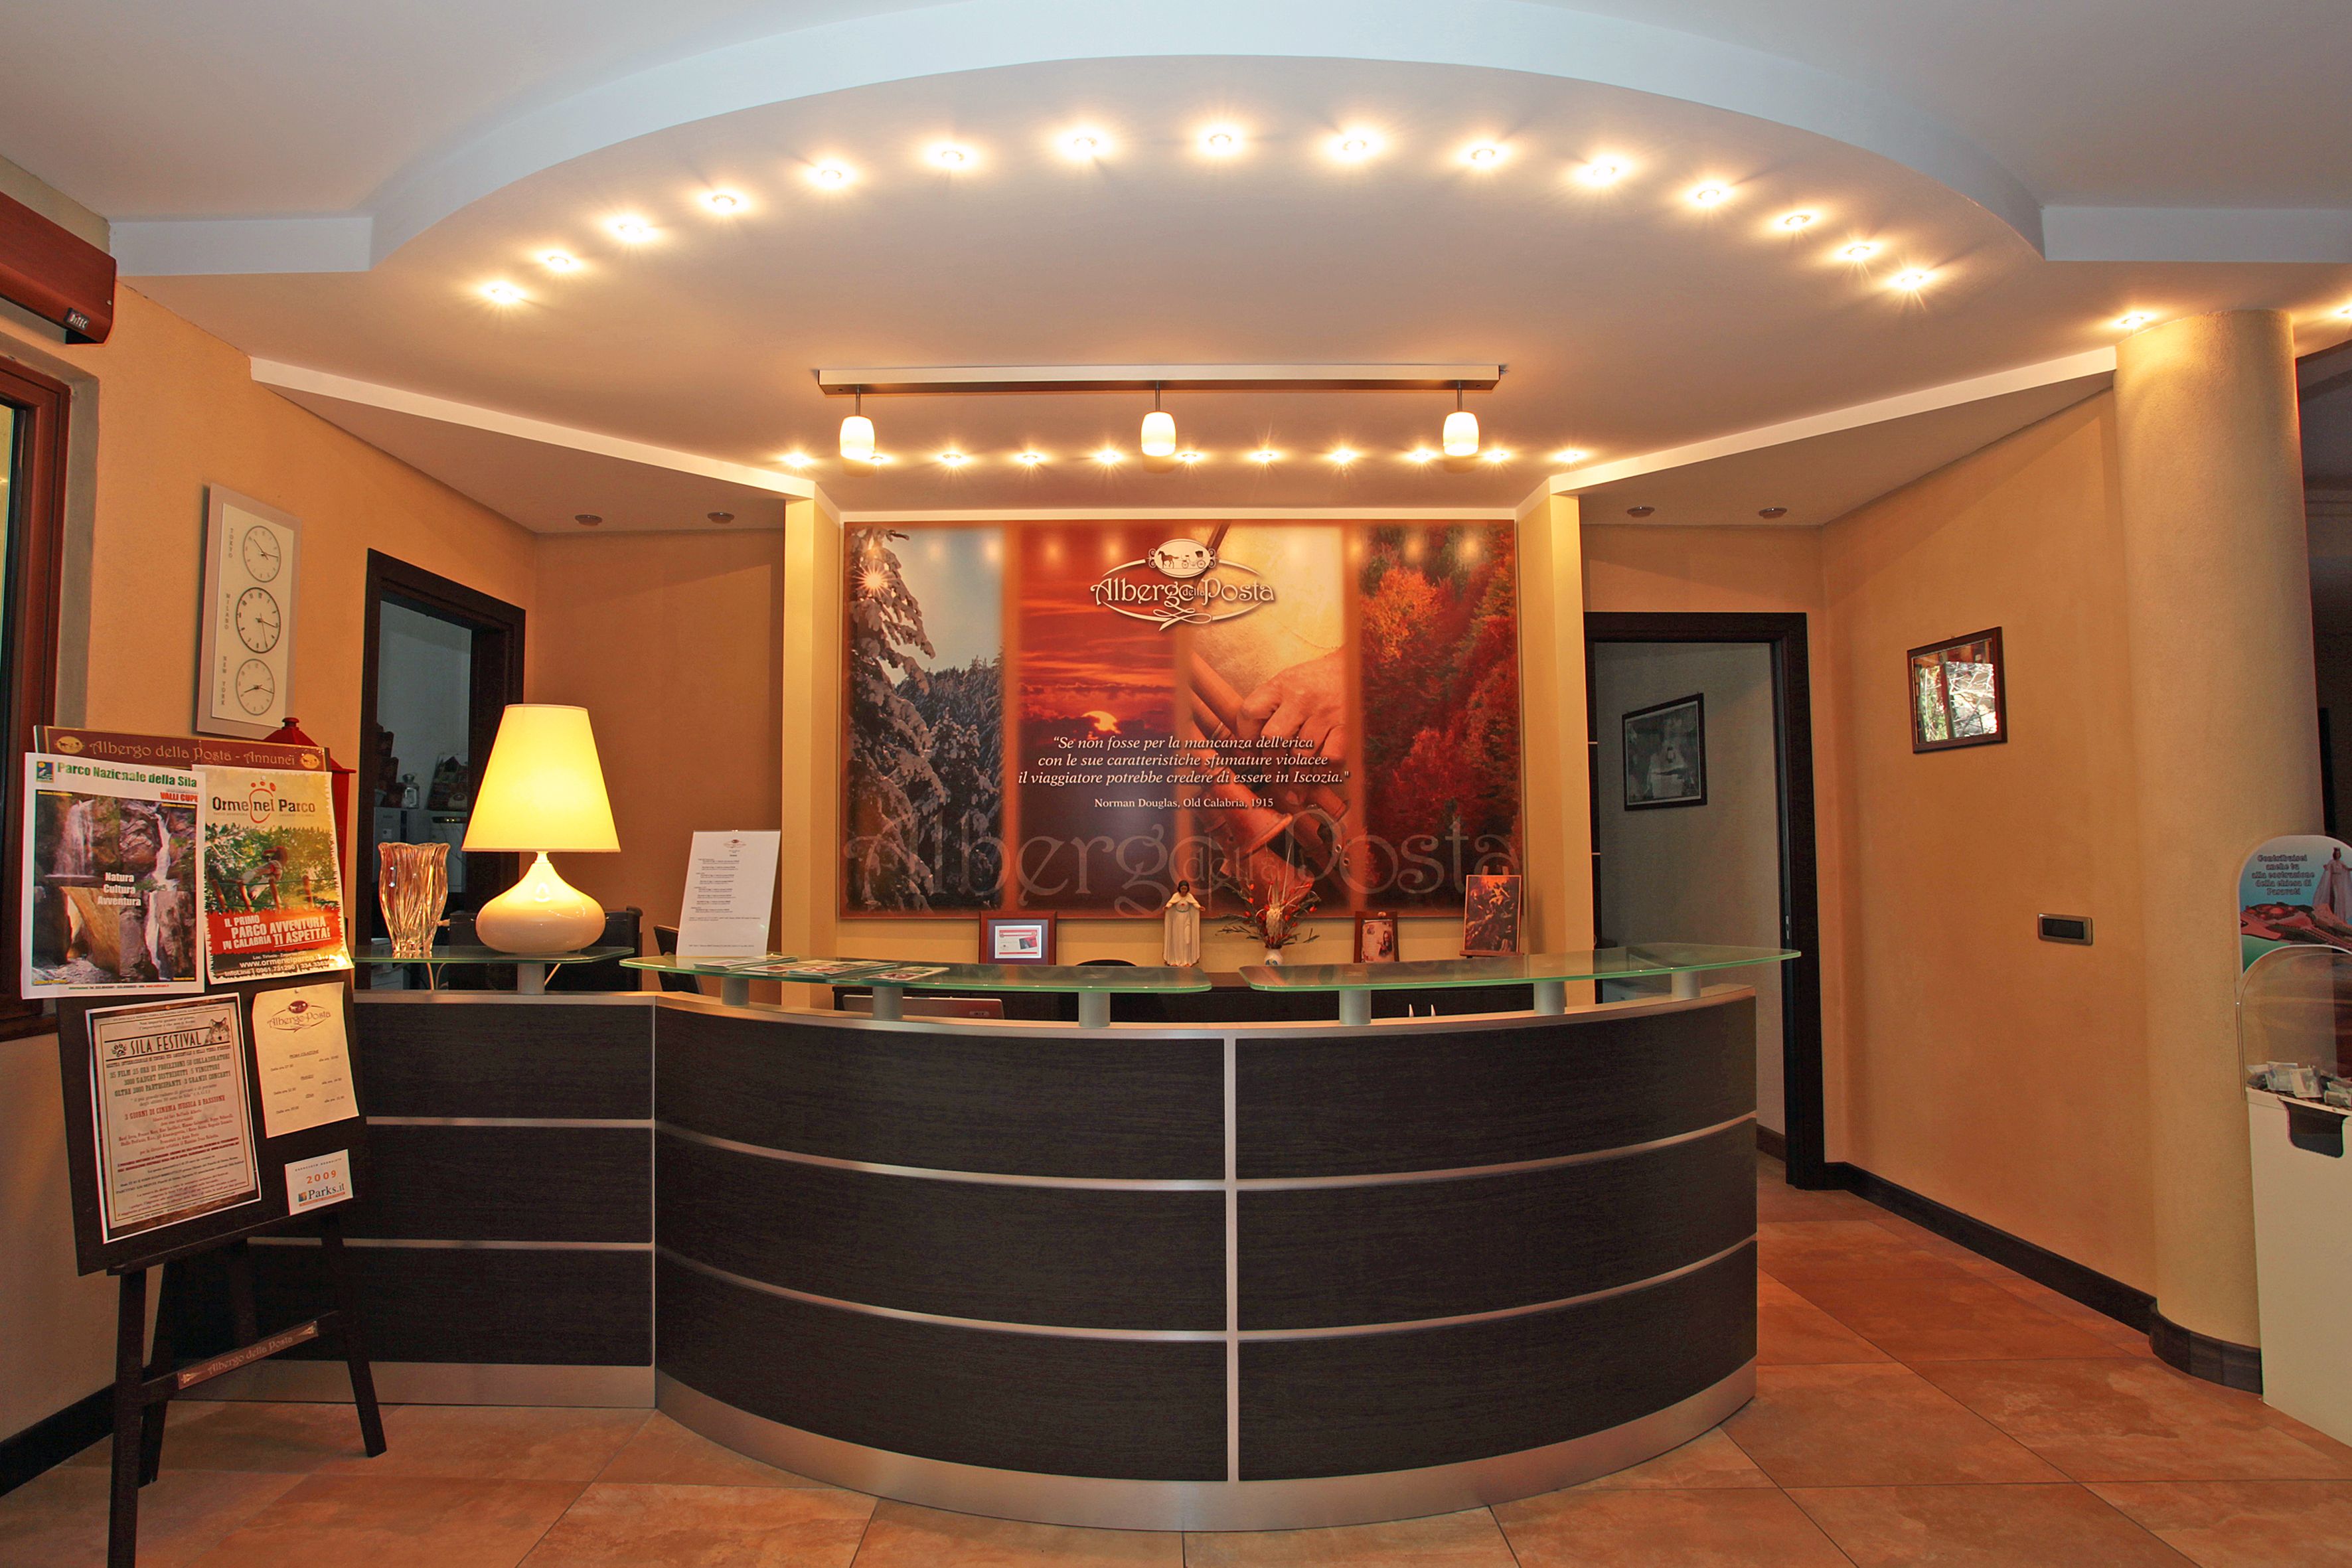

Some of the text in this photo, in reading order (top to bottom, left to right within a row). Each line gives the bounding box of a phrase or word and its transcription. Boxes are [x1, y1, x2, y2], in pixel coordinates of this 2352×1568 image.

[1090, 578, 1275, 608] Albergo della Posta
[1078, 740, 1103, 749] non
[1107, 736, 1140, 751] fosse
[1143, 740, 1166, 751] per
[1168, 736, 1180, 749] la
[1184, 739, 1252, 749] mancanza
[1256, 736, 1314, 748] dell'erica
[89, 740, 152, 759] Albergo
[155, 745, 190, 759] della
[193, 747, 232, 762] Posta
[243, 751, 295, 765] Annunci
[1038, 753, 1328, 768] con le sue caratteristiche sfumature violacee
[57, 762, 197, 787] Parco Nazionale della Sila
[1018, 771, 1350, 786] il viaggiatore potrebbe credere di essere in Iscozia."
[160, 791, 179, 801] VALLI
[181, 793, 198, 803] CUPE
[1095, 798, 1274, 809] Norman Douglas, Old Calabria, 1915
[212, 797, 249, 811] Orme
[254, 799, 275, 812] nel
[279, 799, 316, 813] Parco
[105, 872, 135, 882] Natura
[103, 884, 136, 894] Cultura
[2266, 888, 2301, 896] Paravati
[98, 896, 141, 906] Avventura
[224, 915, 260, 927] IL PRIMO
[231, 916, 327, 939] PARCO AVVENTURA
[222, 926, 331, 950] IN CALABRIA TI ASPETTA!
[307, 1010, 331, 1022] Posta
[131, 1038, 156, 1055] SILA
[157, 1031, 202, 1051] FESTIVAL
[156, 1105, 177, 1115] CINEMA
[178, 1101, 197, 1111] MUSICA
[203, 1095, 226, 1105] PASSIONE
[307, 1170, 337, 1184] 2009
[308, 1182, 345, 1200] Parks.it
[207, 1336, 293, 1375] Albergo della Posta
